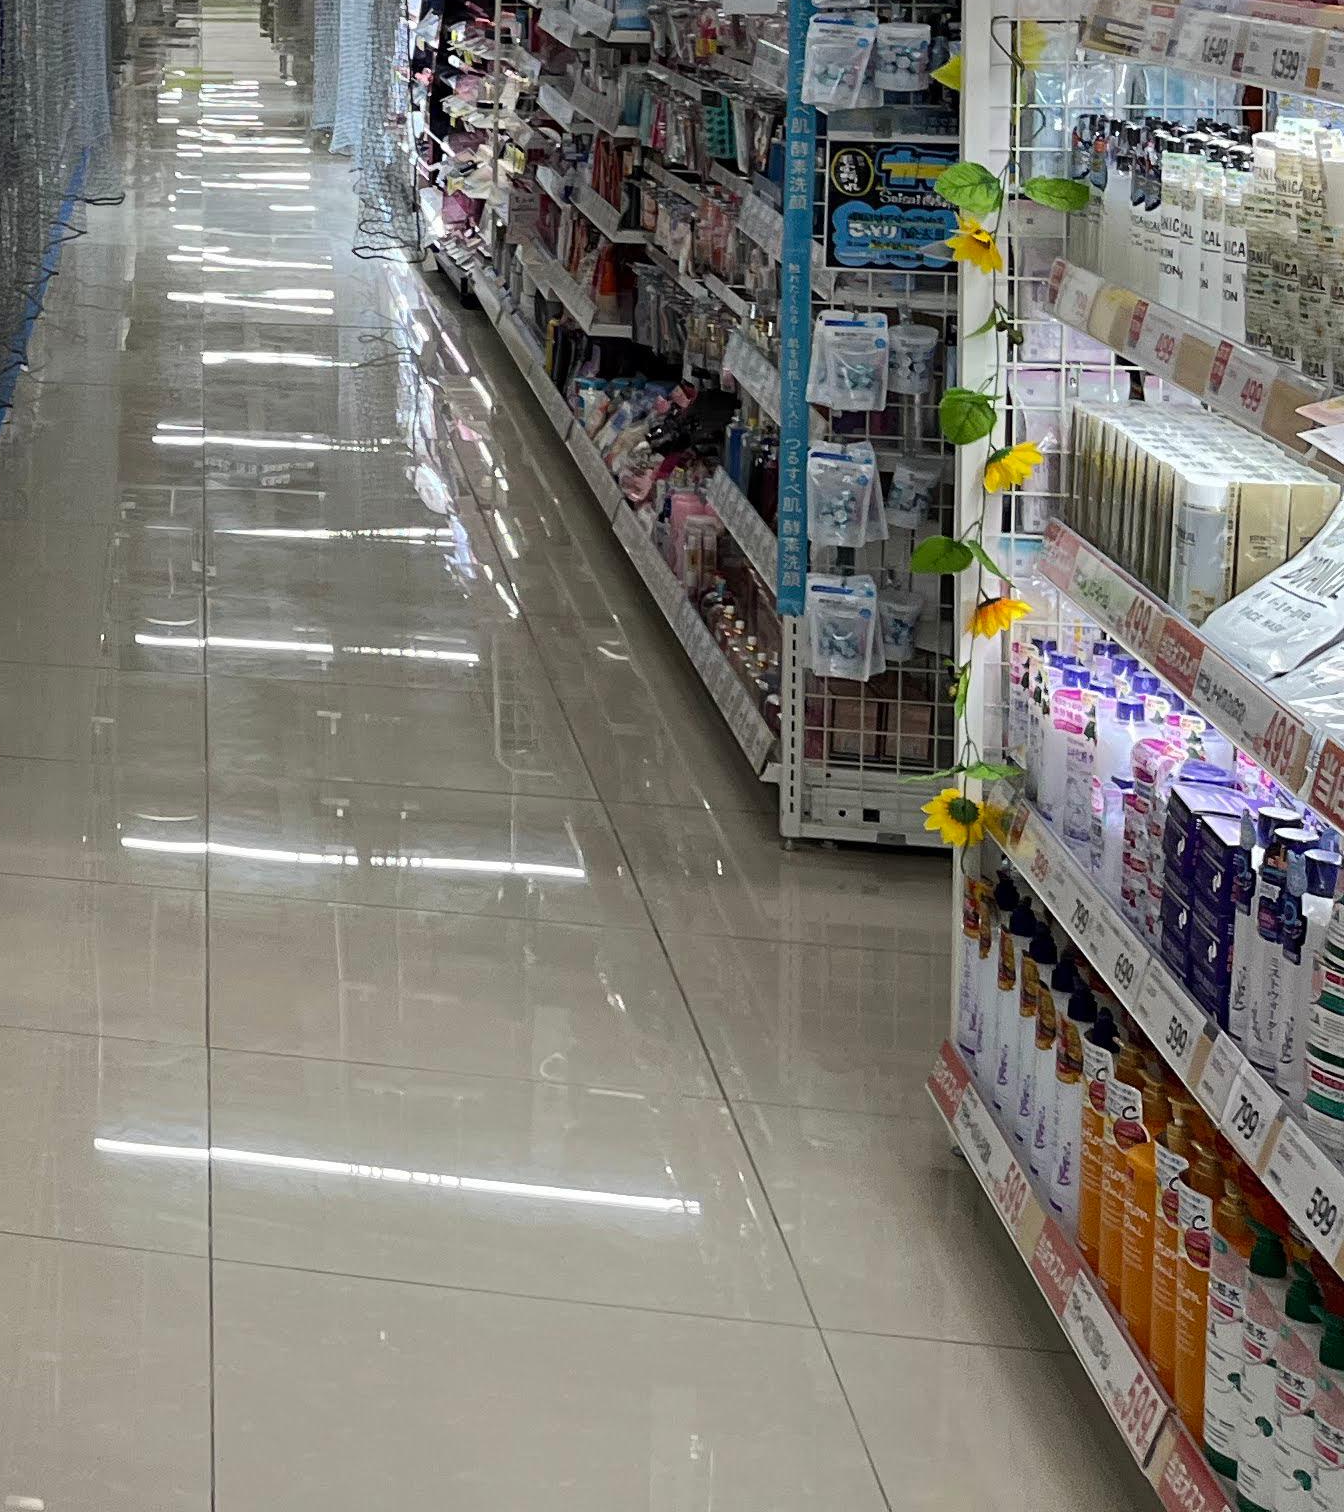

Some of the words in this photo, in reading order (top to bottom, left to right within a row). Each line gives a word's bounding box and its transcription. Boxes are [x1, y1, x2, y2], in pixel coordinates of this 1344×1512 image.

[1114, 952, 1135, 991] 699
[1230, 1093, 1260, 1141] 799
[1305, 1187, 1338, 1238] 599
